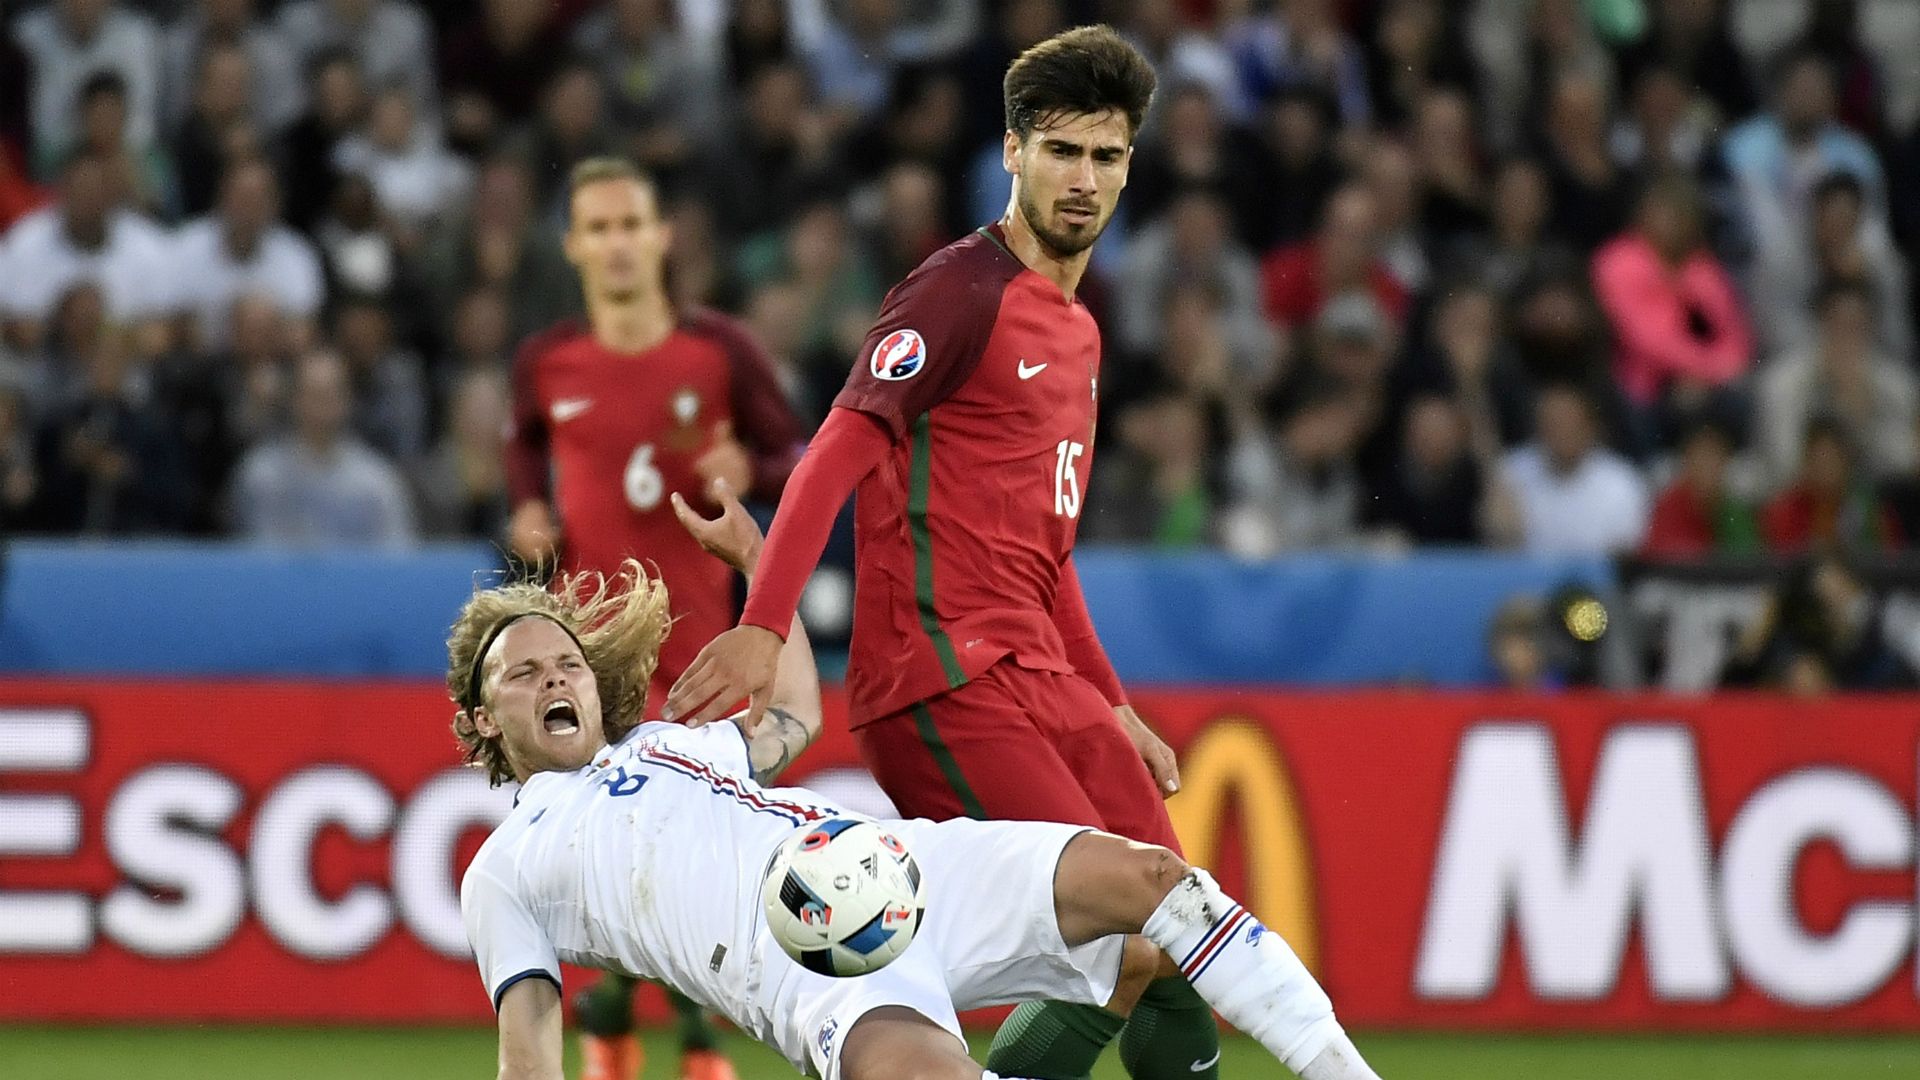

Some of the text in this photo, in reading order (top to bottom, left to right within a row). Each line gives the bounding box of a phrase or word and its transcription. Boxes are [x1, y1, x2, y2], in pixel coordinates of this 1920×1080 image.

[624, 444, 664, 511] 6
[1055, 439, 1083, 519] 15
[1412, 720, 1920, 1009] Mc
